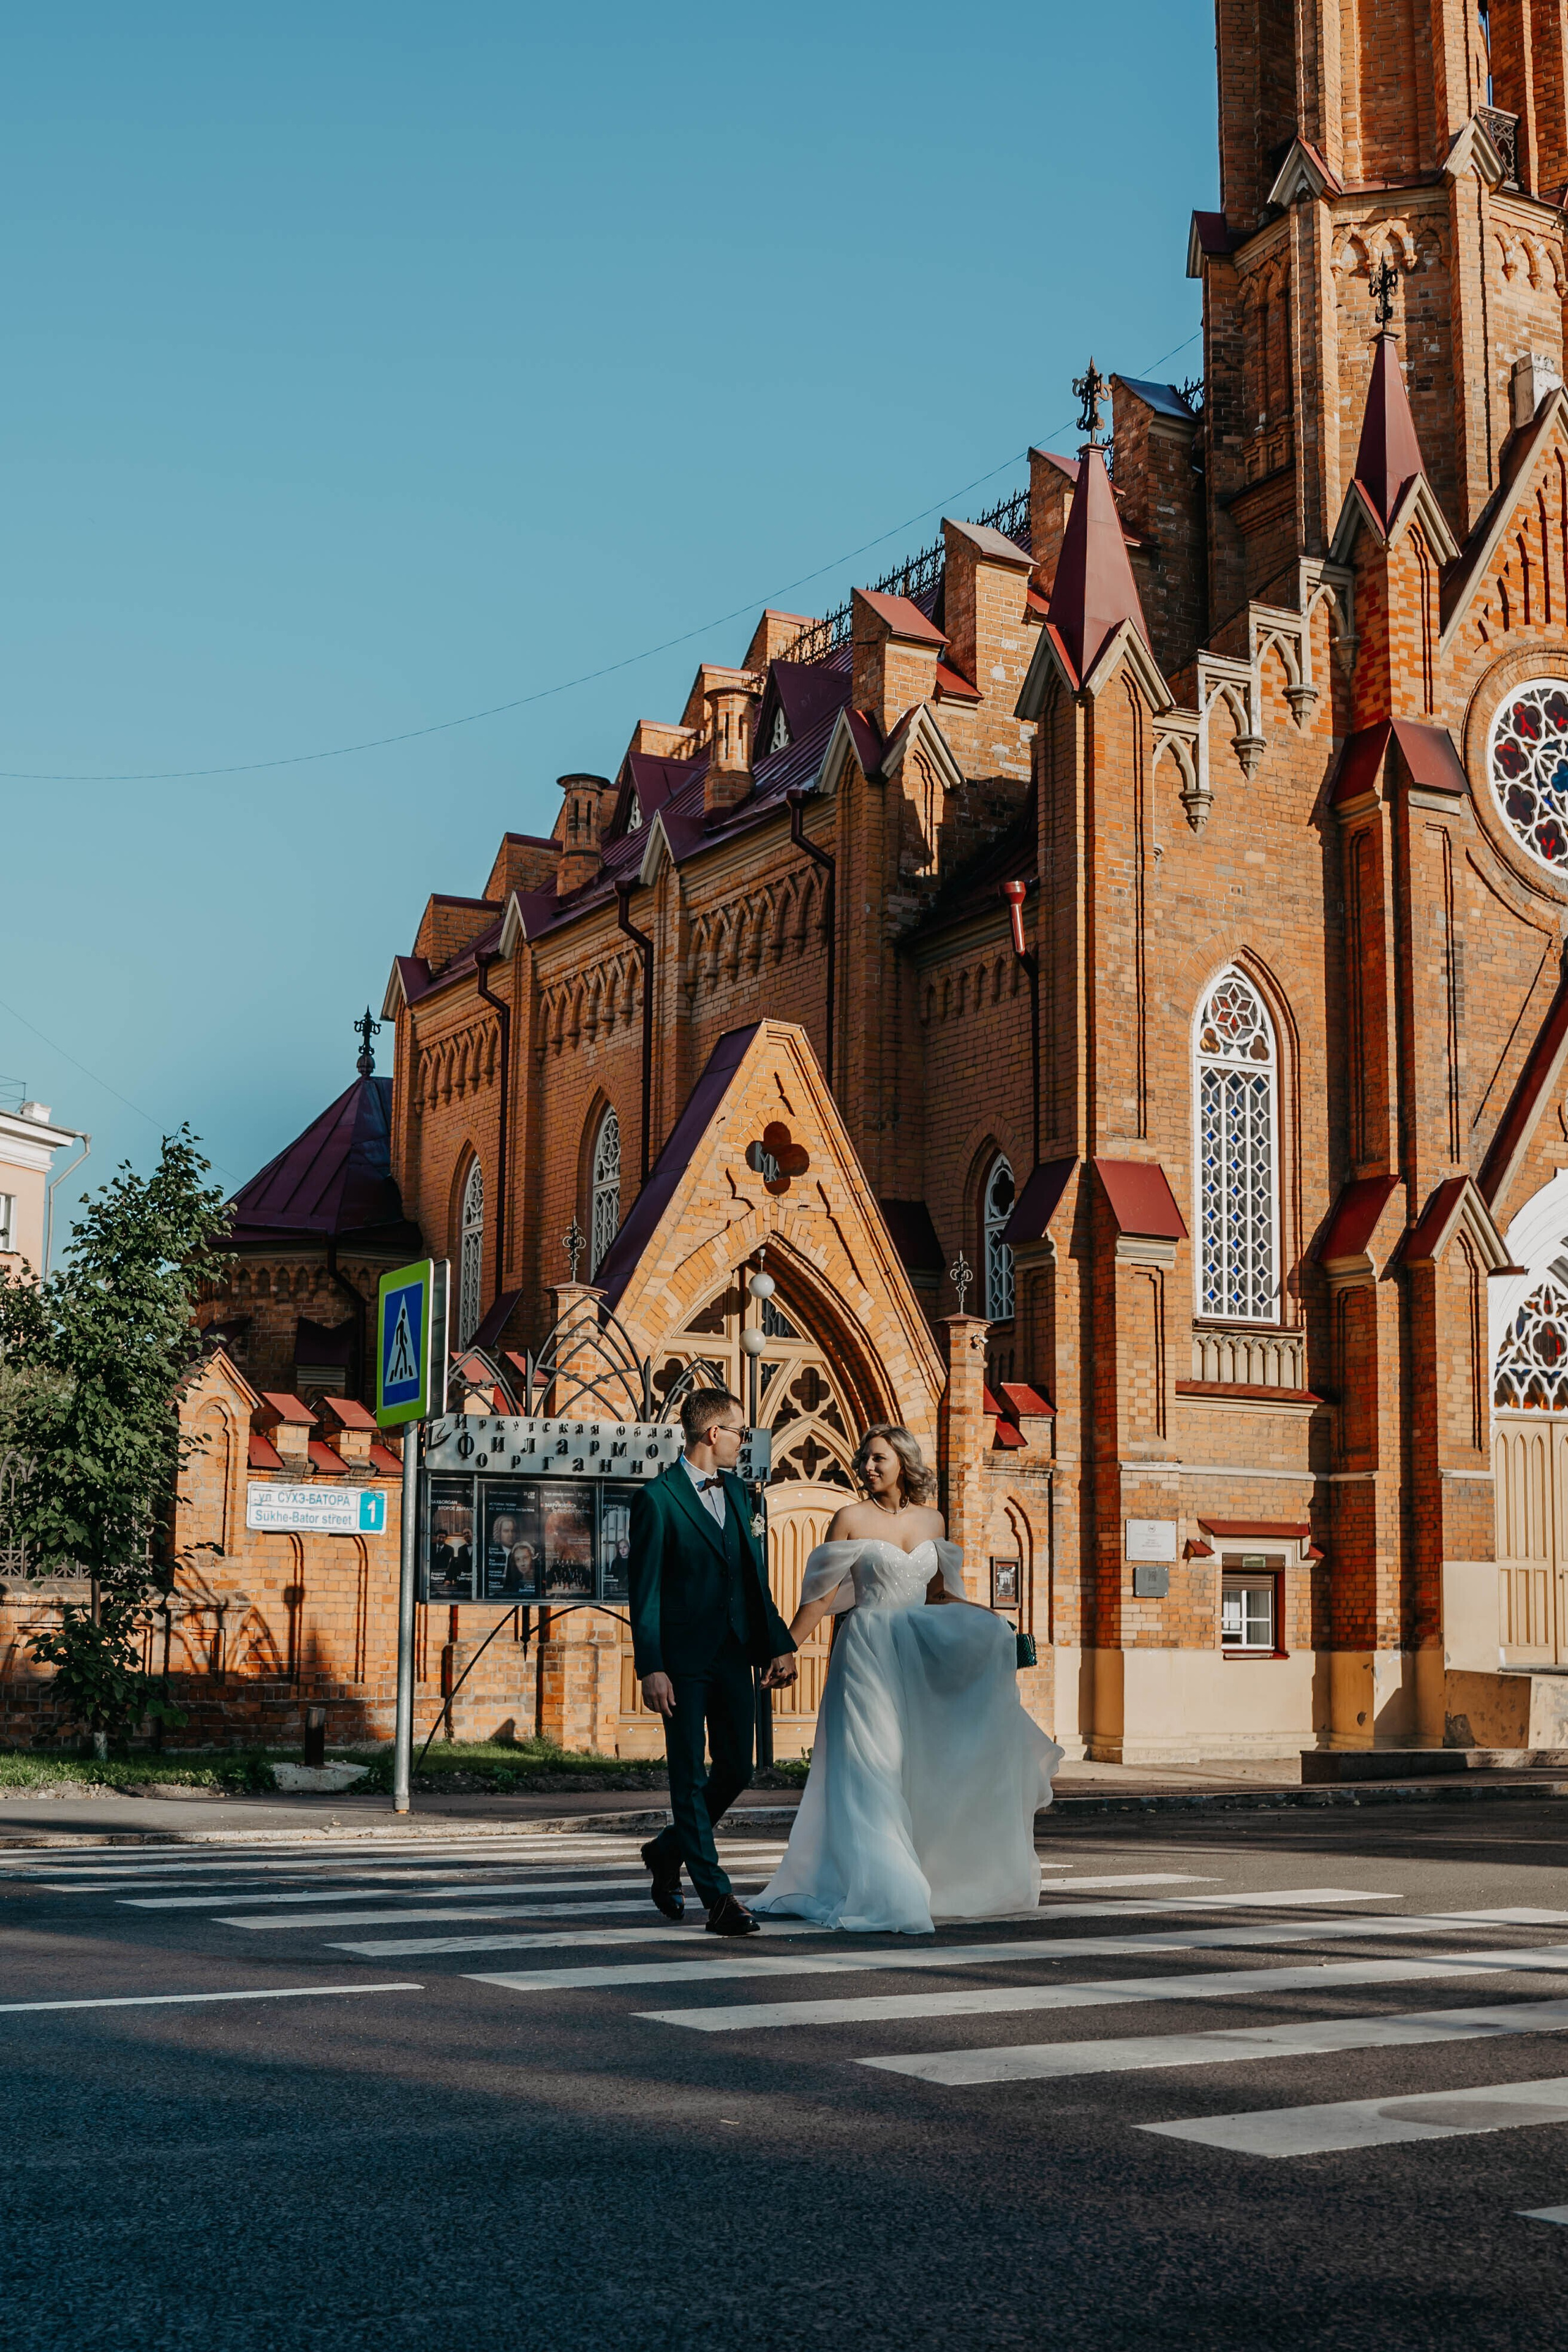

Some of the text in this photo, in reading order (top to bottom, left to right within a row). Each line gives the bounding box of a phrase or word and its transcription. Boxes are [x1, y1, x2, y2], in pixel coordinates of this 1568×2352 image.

[454, 1414, 600, 1436] Иркутская
[277, 1491, 350, 1506] СУХЭ-БАТОРА
[255, 1509, 352, 1525] Sukhe-Bator street
[368, 1499, 376, 1523] 1
